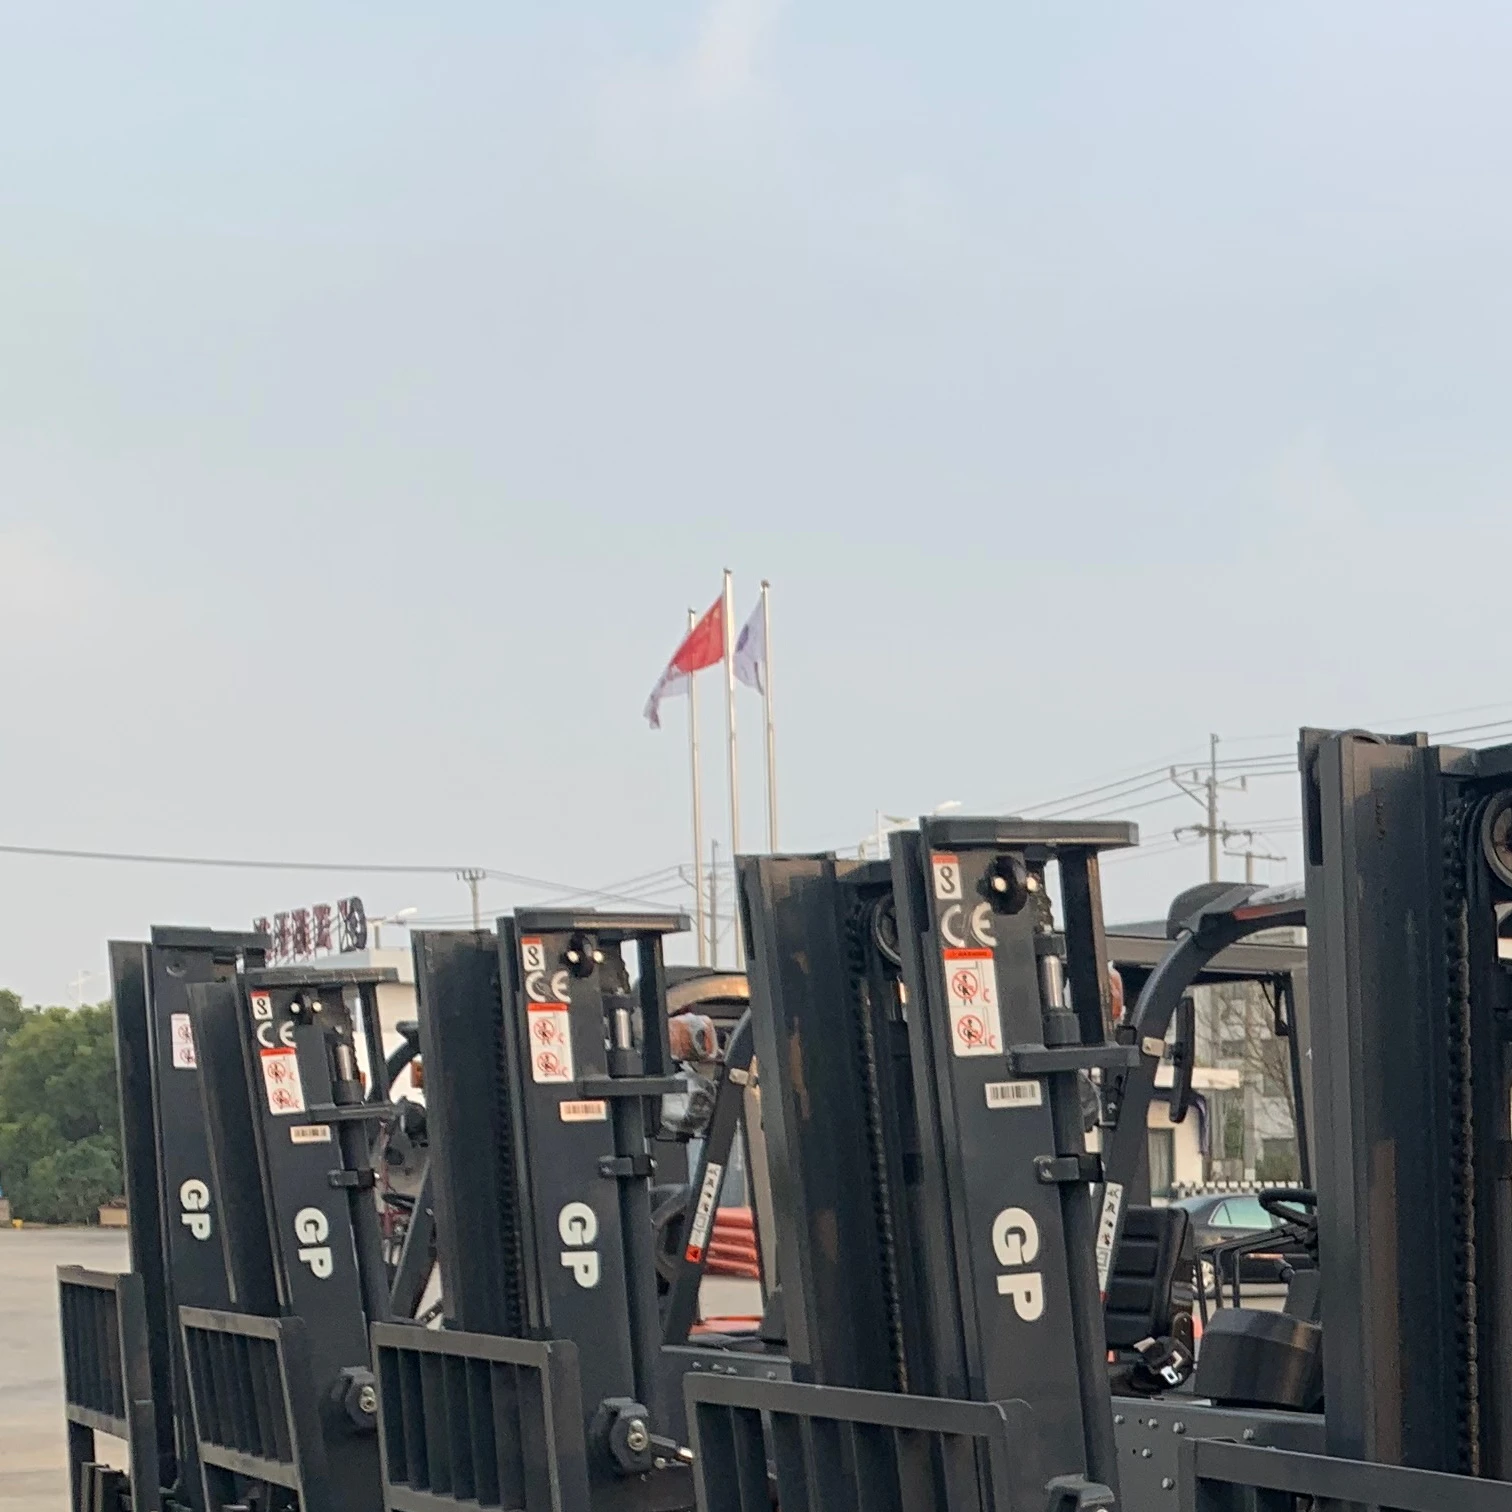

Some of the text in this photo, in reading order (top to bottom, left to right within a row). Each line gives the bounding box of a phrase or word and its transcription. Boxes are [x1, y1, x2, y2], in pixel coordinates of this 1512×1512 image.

[940, 901, 998, 948] CE
[525, 969, 572, 1004] CE
[180, 1179, 211, 1239] GP
[295, 1207, 333, 1278] GP
[558, 1202, 599, 1288] GP
[992, 1207, 1044, 1321] GP
